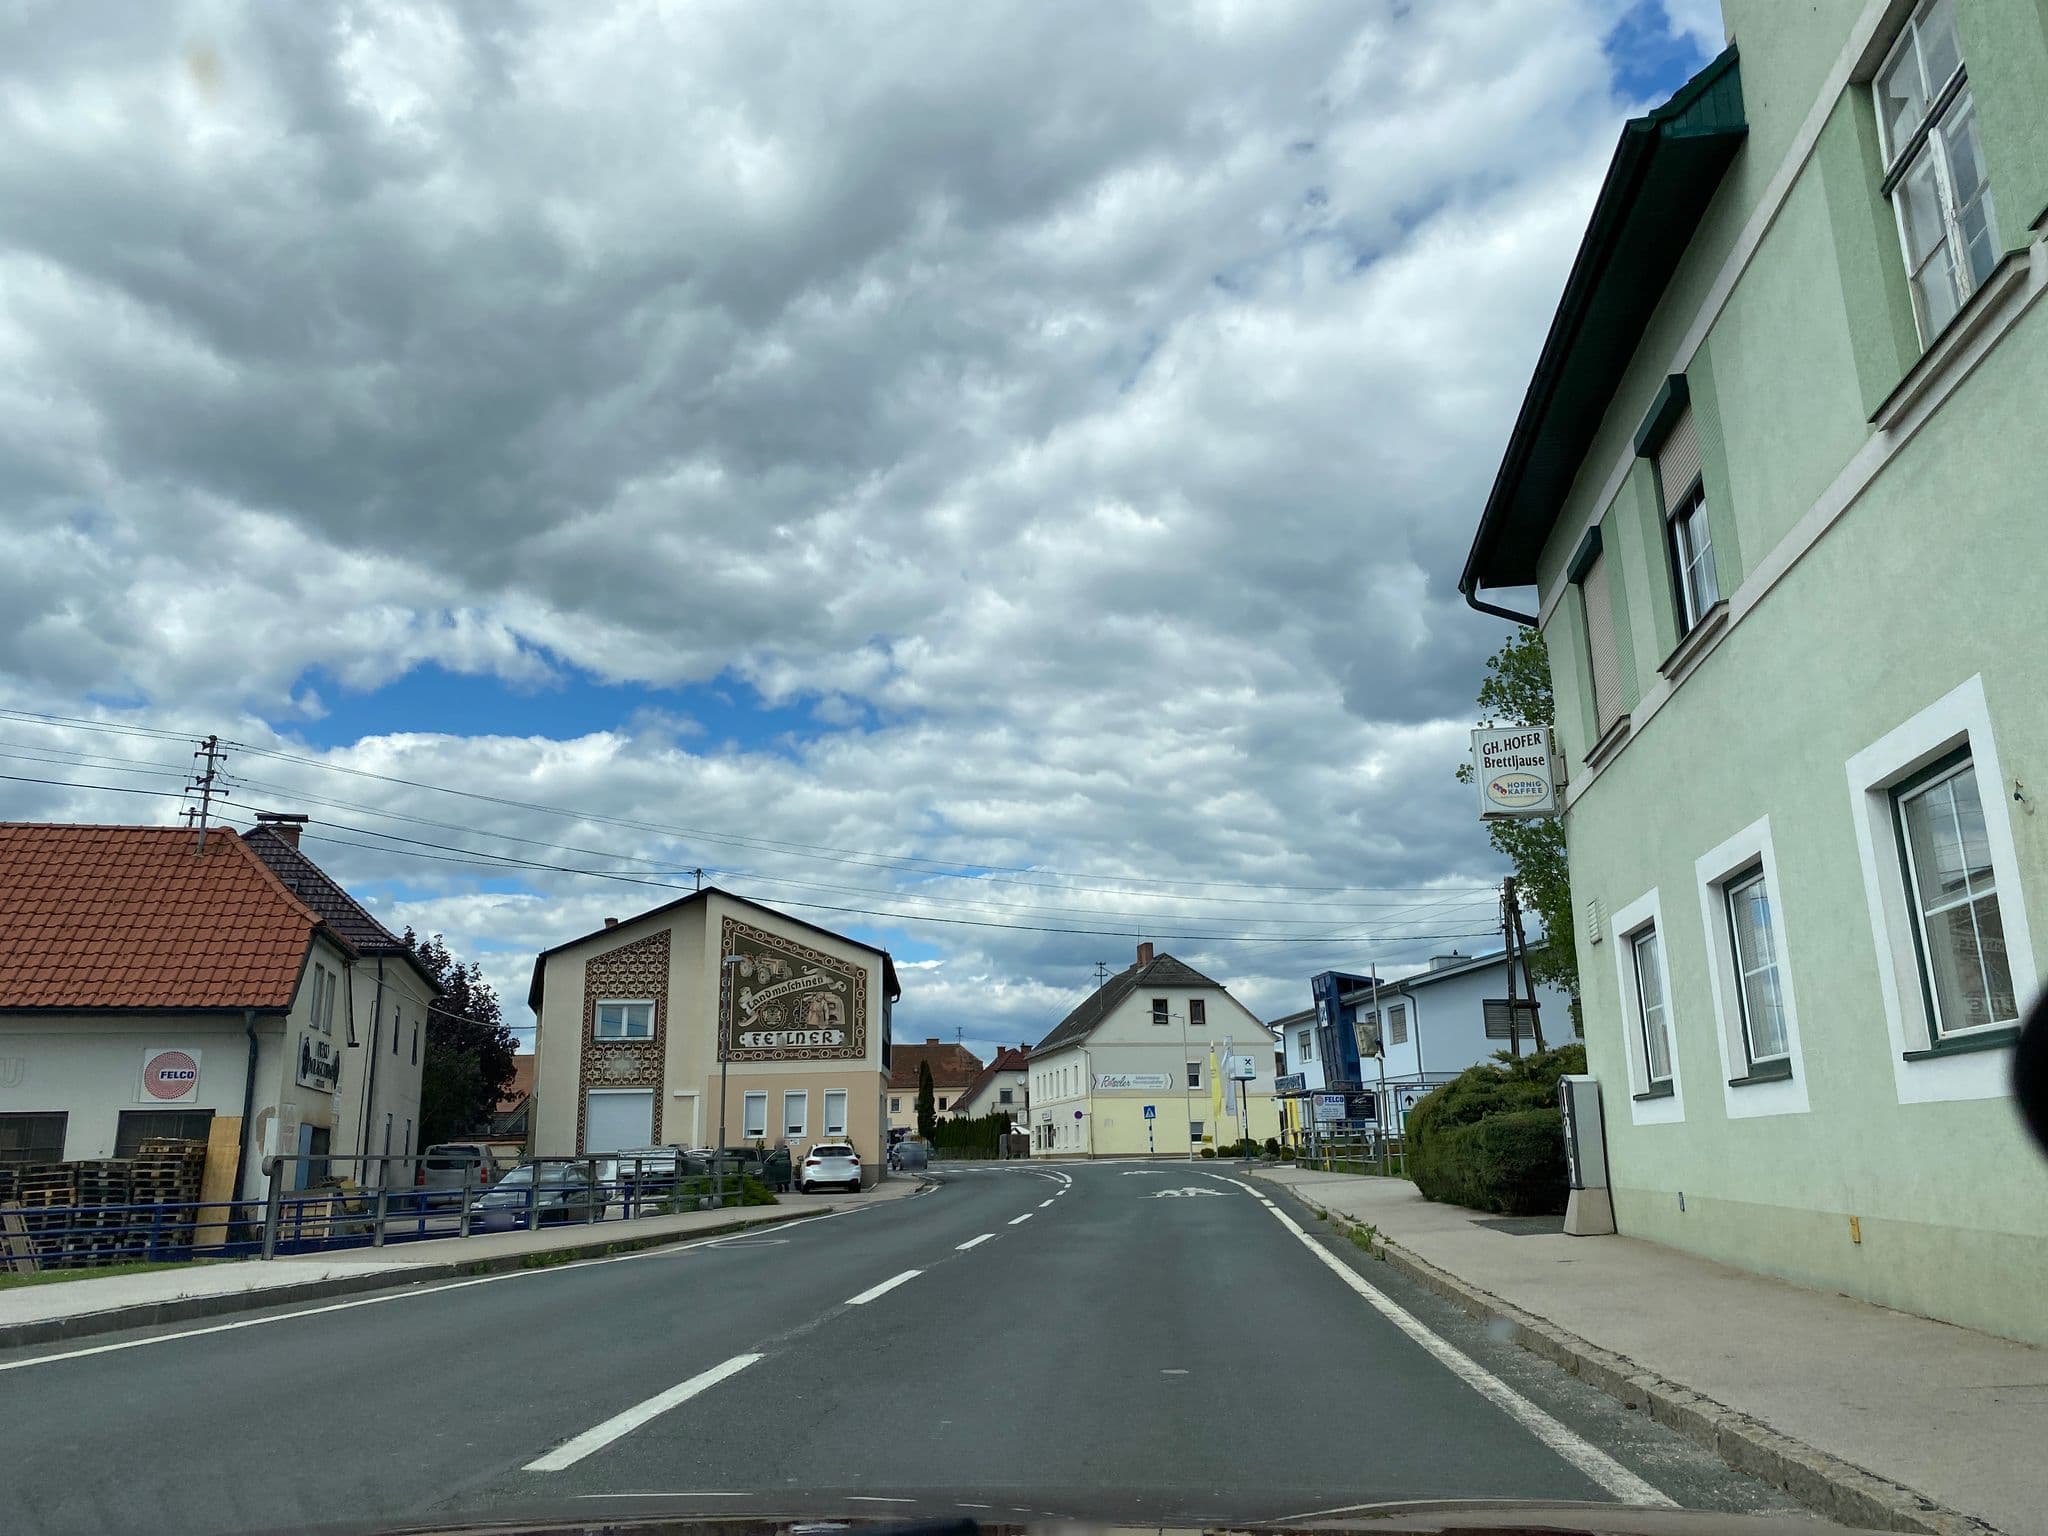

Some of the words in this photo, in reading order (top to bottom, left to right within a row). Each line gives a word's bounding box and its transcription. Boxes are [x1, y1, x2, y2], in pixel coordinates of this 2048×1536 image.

[1482, 740, 1503, 756] GH.
[1504, 732, 1542, 751] HOFER
[1483, 755, 1545, 770] Brettljause
[1507, 780, 1542, 788] HORNIG
[1507, 787, 1543, 795] KAFFEE
[160, 1070, 194, 1080] FELCO
[1324, 1096, 1344, 1104] FELCO
